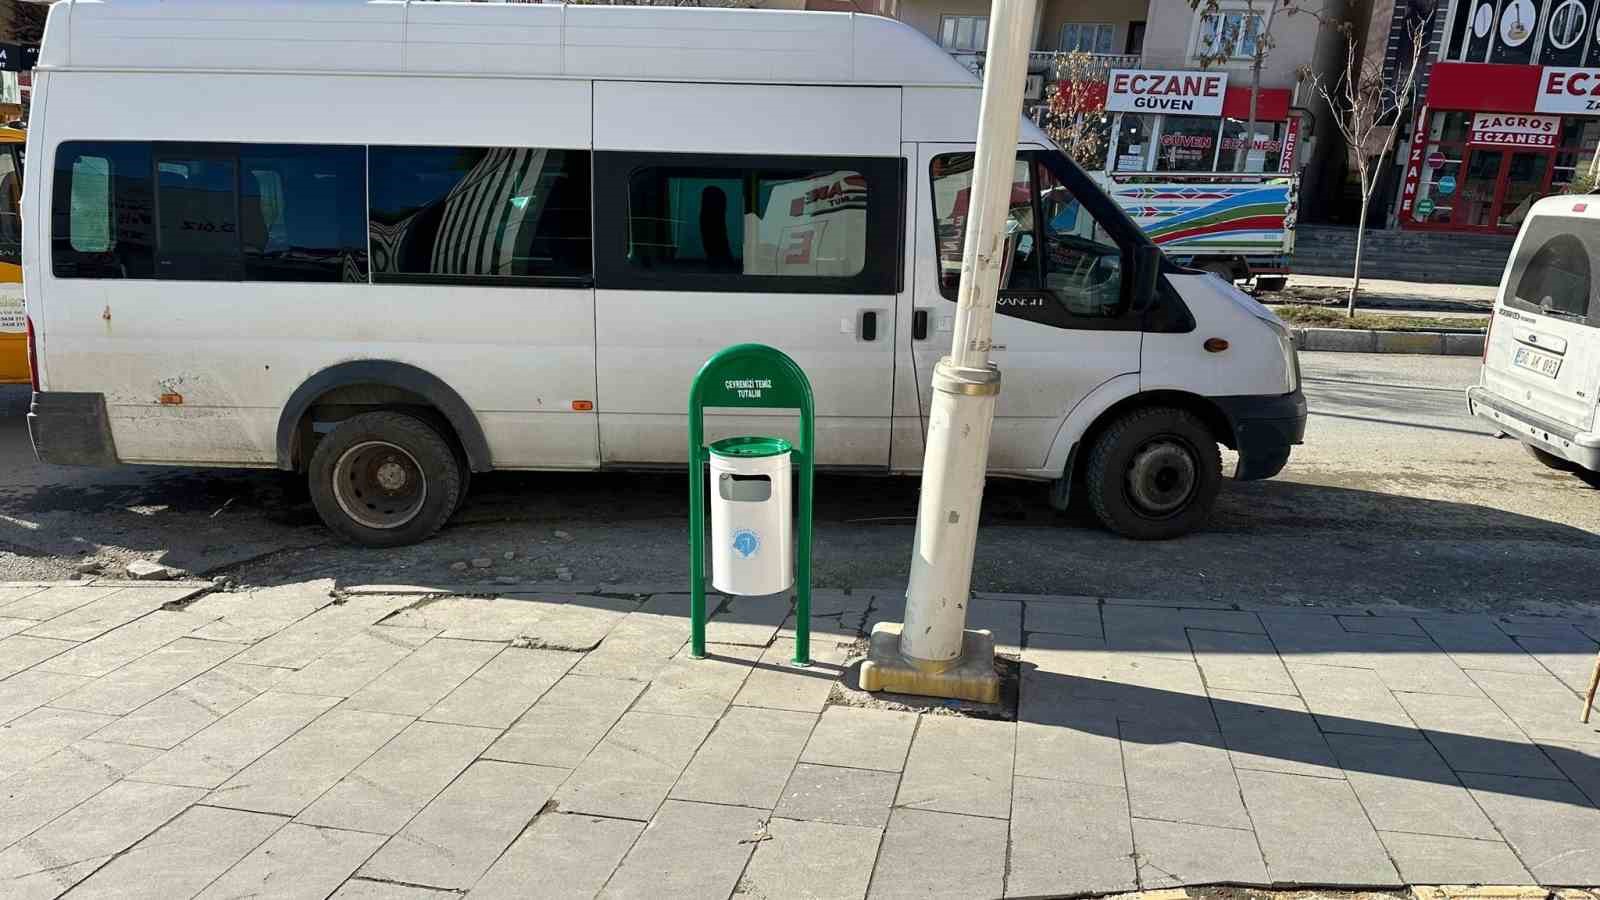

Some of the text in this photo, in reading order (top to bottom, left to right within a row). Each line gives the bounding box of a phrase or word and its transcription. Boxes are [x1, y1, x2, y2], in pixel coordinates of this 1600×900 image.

[1113, 74, 1220, 96] ECZANE
[1134, 96, 1194, 110] GÜVEN
[1479, 116, 1553, 132] ZAGROS
[1402, 117, 1425, 211] CZANE
[737, 389, 761, 399] TUTALIM
